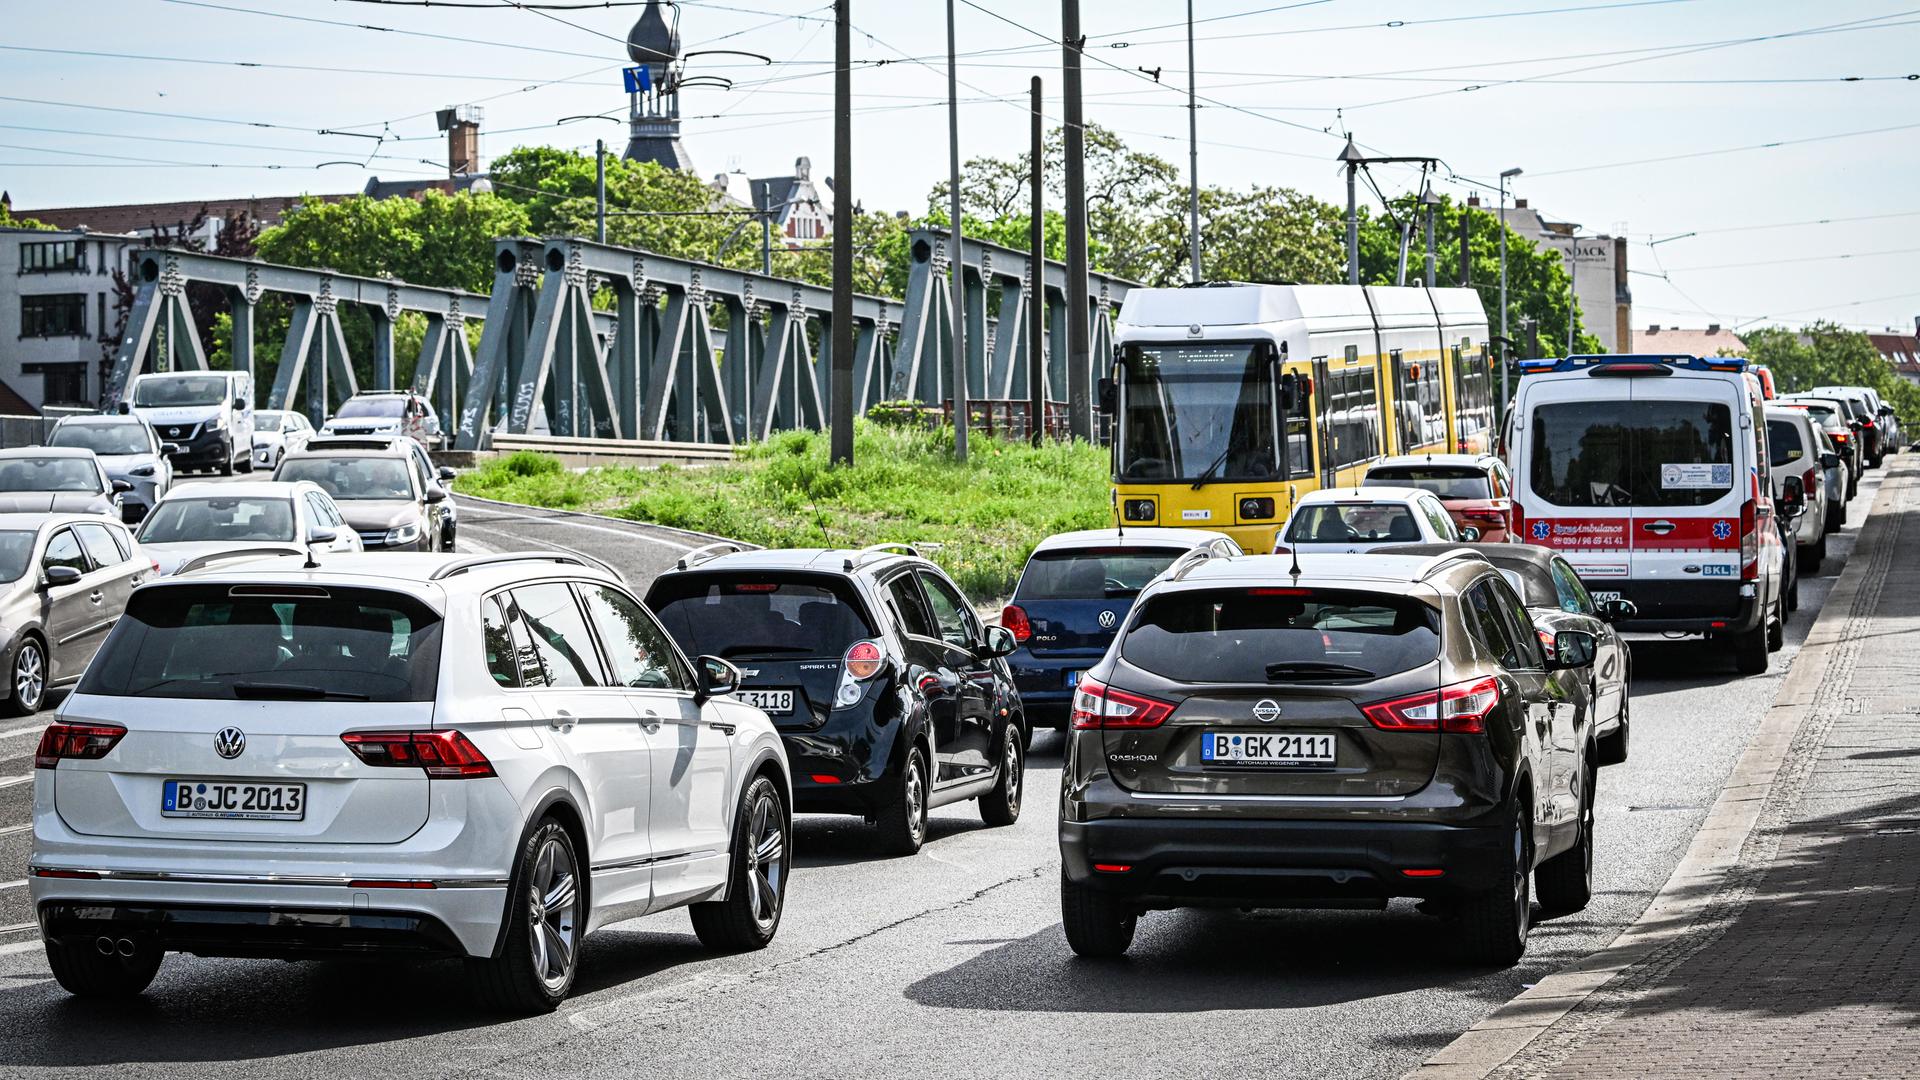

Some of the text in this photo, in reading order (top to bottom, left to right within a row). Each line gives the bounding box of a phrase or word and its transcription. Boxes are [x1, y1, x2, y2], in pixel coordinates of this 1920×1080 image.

[1703, 566, 1729, 575] BKL
[750, 692, 791, 709] 3118
[1216, 736, 1230, 757] B
[1244, 736, 1273, 758] GK
[1278, 737, 1332, 759] 2111
[1109, 754, 1158, 762] QASHQAI
[167, 785, 300, 811] D B JC 2013
